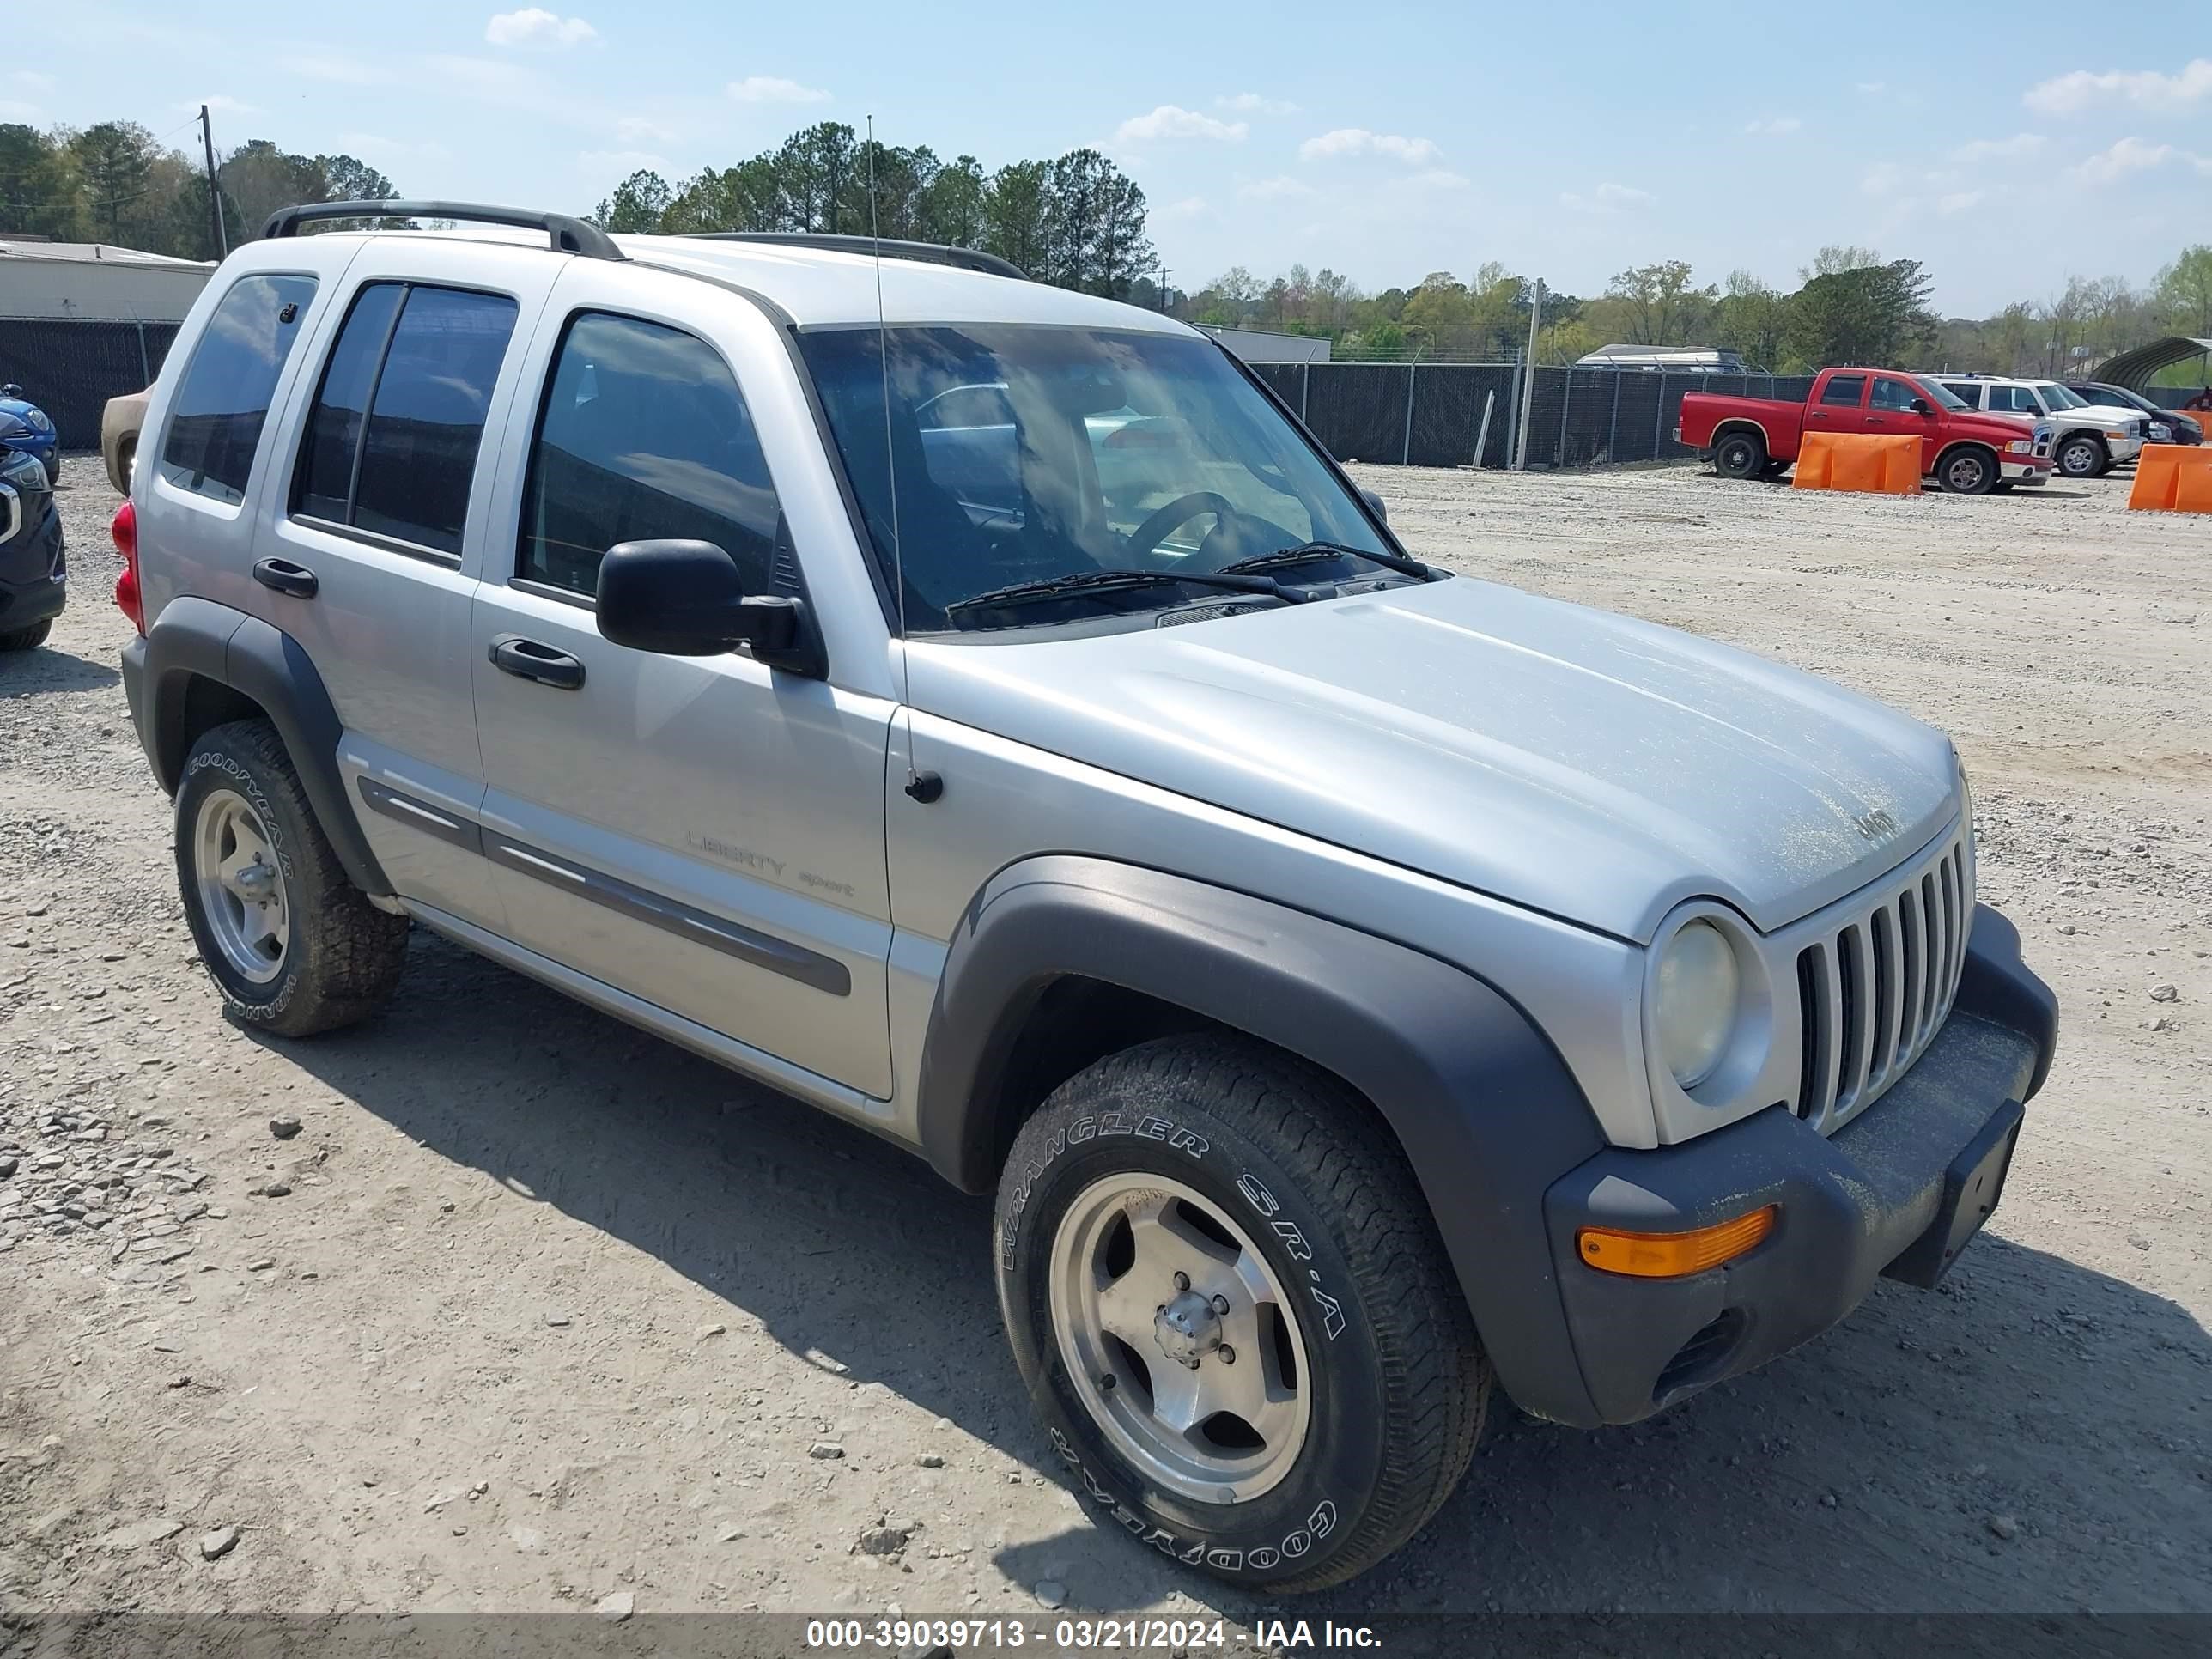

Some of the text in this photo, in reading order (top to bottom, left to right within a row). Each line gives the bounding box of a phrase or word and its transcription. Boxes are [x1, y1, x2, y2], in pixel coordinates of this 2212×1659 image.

[189, 752, 295, 879] GOODYEAR
[687, 830, 787, 879] LIBERTY
[1002, 1113, 1210, 1271] WRANGLER
[1050, 1426, 1337, 1571] GOODYEAR
